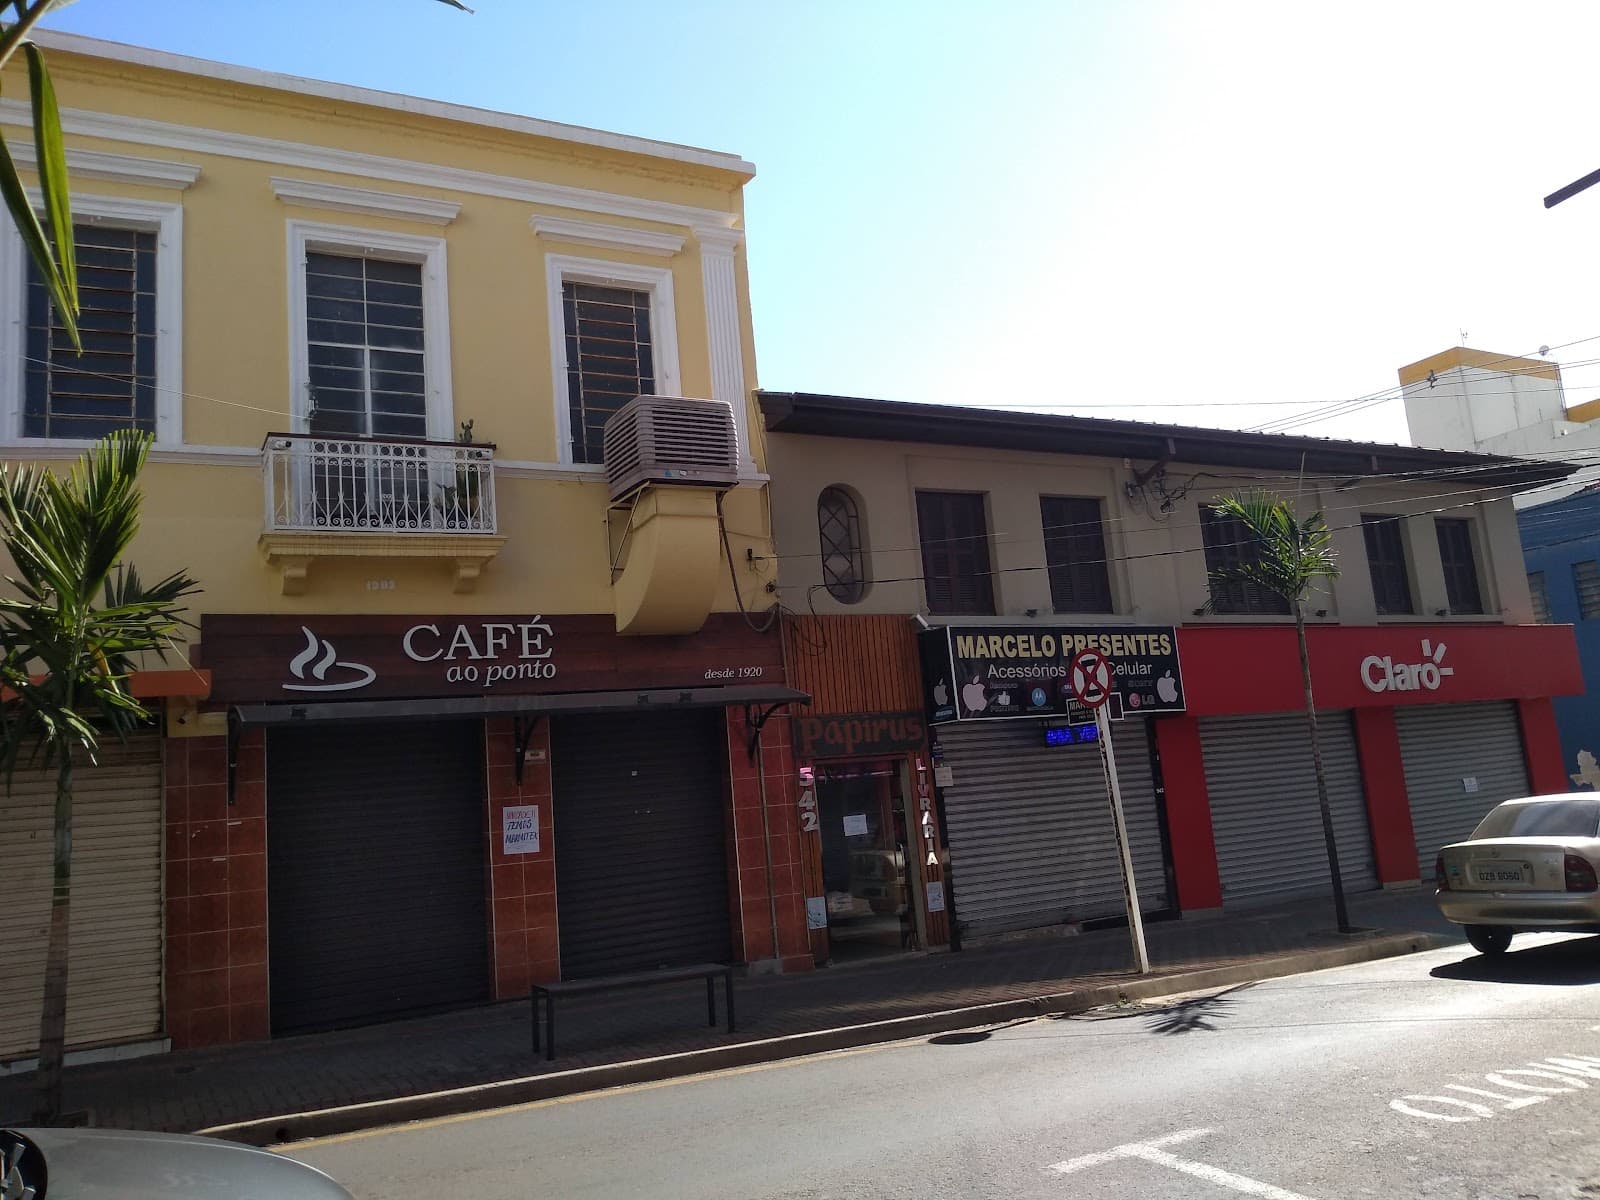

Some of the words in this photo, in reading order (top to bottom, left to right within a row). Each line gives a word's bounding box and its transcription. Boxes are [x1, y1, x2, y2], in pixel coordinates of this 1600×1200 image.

[403, 614, 554, 662] CAFÉ
[956, 634, 1055, 659] MARCELO
[1060, 633, 1172, 657] PRESENTES
[446, 665, 479, 682] ao
[483, 659, 557, 687] ponto
[704, 668, 735, 680] desde
[738, 666, 763, 678] 1920
[987, 662, 1067, 680] Acessórios
[1360, 655, 1441, 693] Claro
[801, 715, 924, 755] Papirus
[915, 758, 939, 866] LIVRARIA
